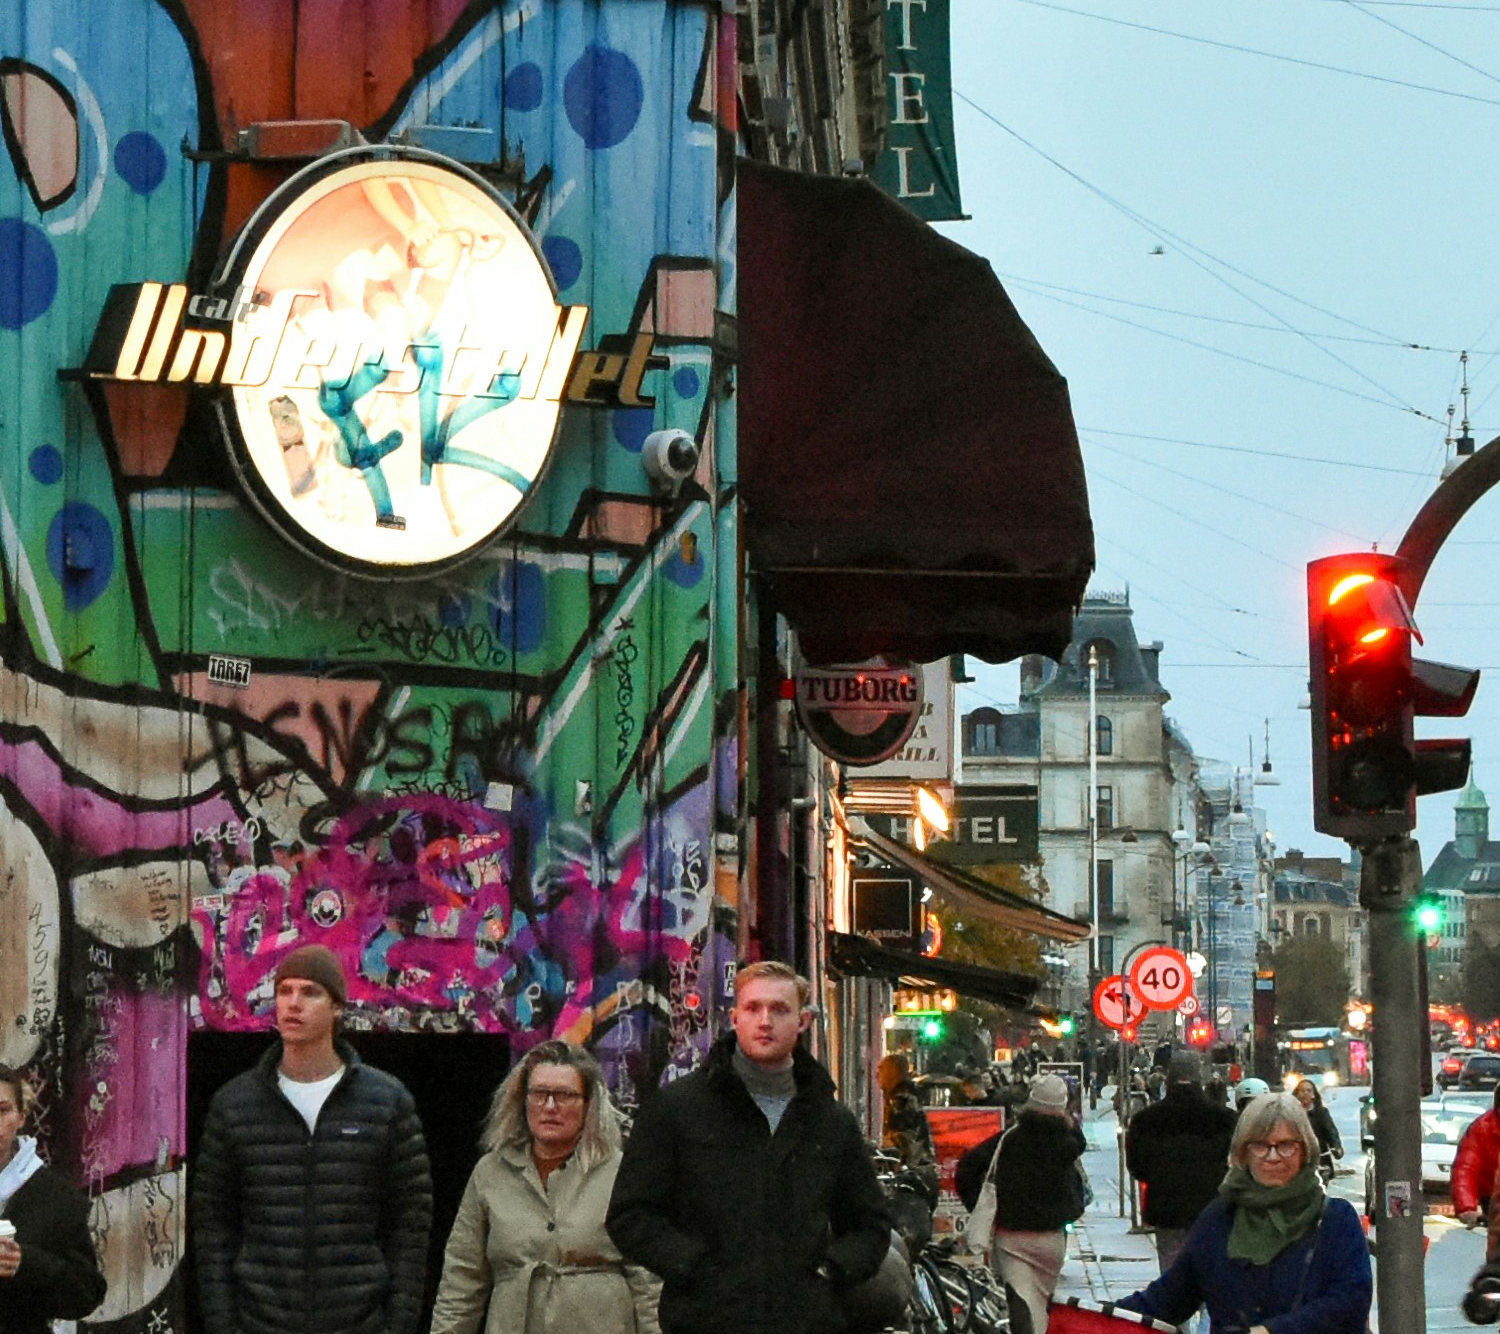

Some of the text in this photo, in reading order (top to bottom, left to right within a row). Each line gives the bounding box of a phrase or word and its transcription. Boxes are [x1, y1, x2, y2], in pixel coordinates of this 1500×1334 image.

[803, 676, 918, 703] TUBORG
[890, 816, 1018, 845] HTEL
[1141, 967, 1181, 990] 40
